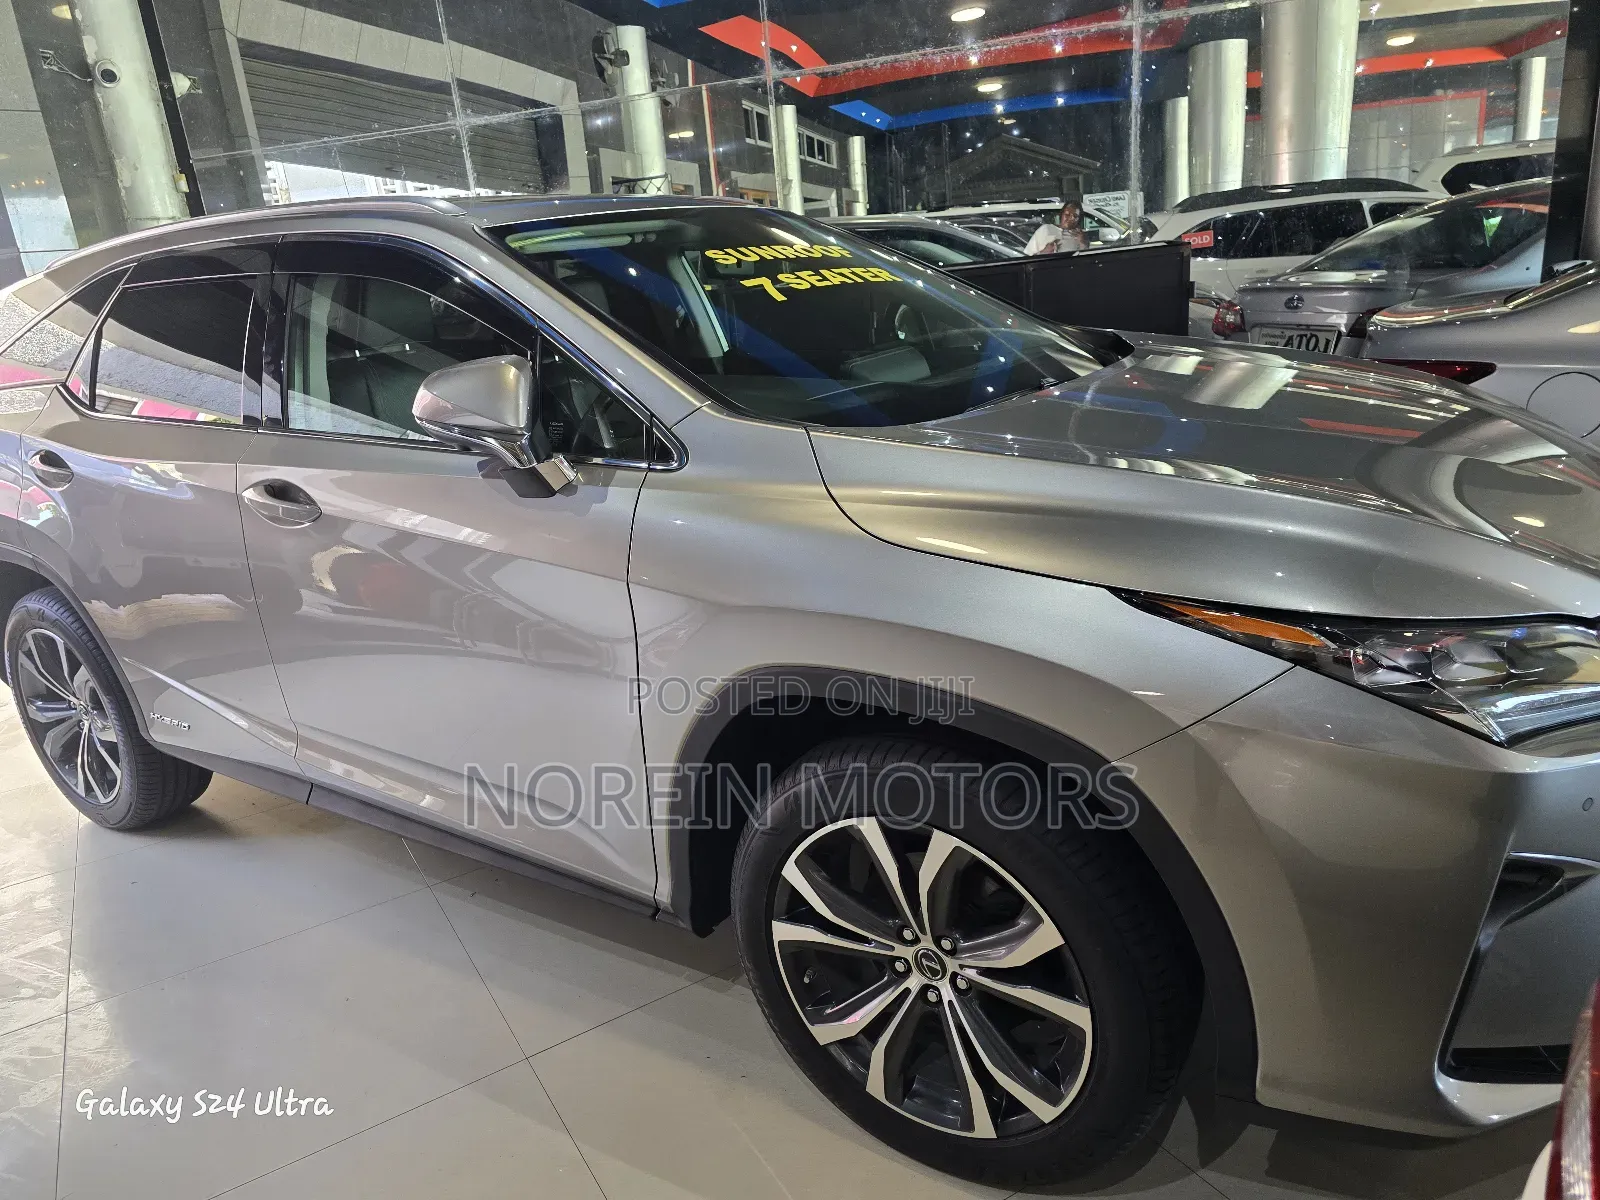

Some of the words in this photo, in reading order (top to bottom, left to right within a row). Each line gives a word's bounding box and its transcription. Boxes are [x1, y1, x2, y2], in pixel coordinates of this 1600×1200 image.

[704, 244, 853, 265] SUNROOF
[739, 276, 788, 302] 7
[776, 267, 904, 290] SEATER
